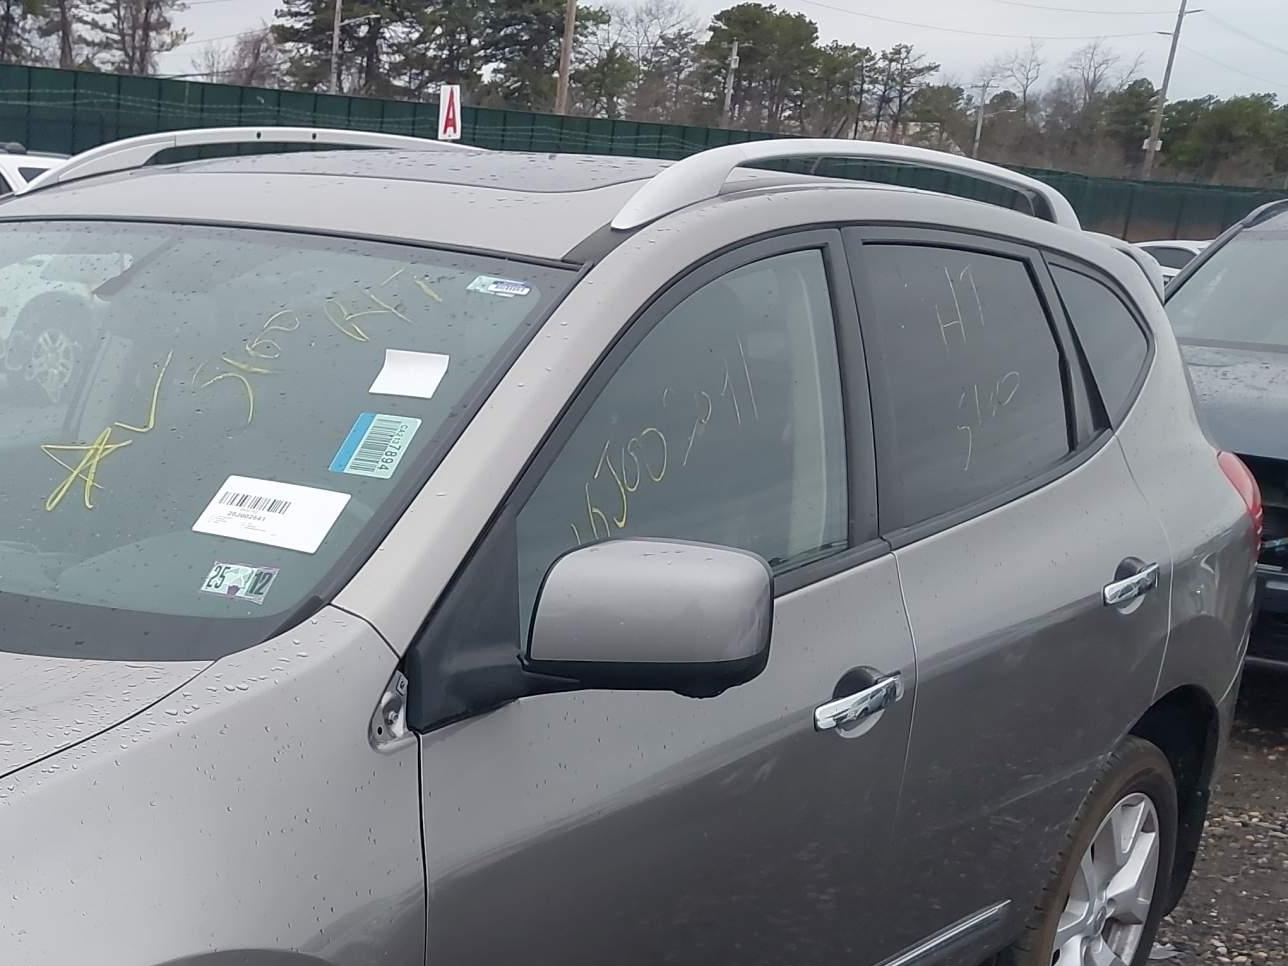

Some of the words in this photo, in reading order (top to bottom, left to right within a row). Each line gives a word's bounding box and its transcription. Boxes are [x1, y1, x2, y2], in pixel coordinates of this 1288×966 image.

[443, 86, 458, 135] A
[206, 565, 230, 589] 25
[246, 571, 273, 596] 12
